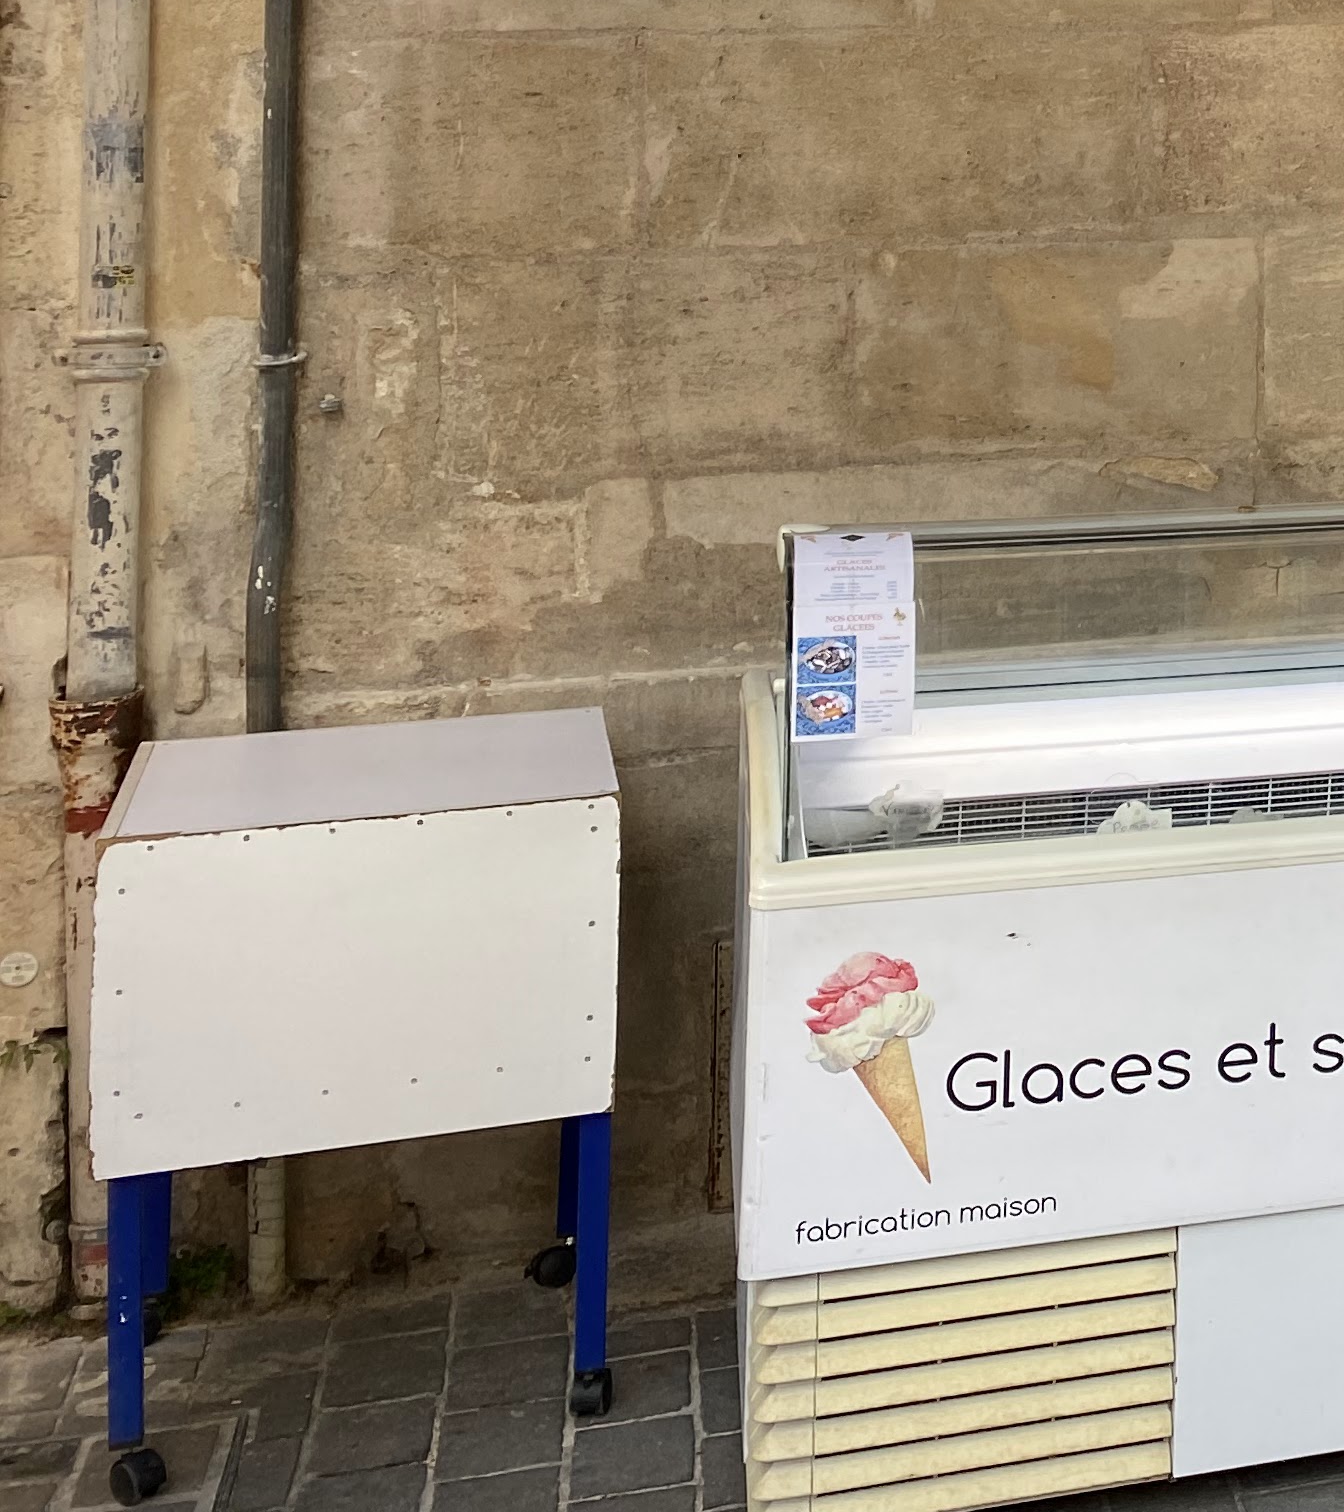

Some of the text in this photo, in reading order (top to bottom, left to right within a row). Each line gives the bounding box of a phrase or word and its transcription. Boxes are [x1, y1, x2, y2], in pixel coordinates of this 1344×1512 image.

[946, 1048, 1191, 1112] Glaces
[1217, 1022, 1286, 1083] et
[795, 1194, 1057, 1245] fabrication maison
